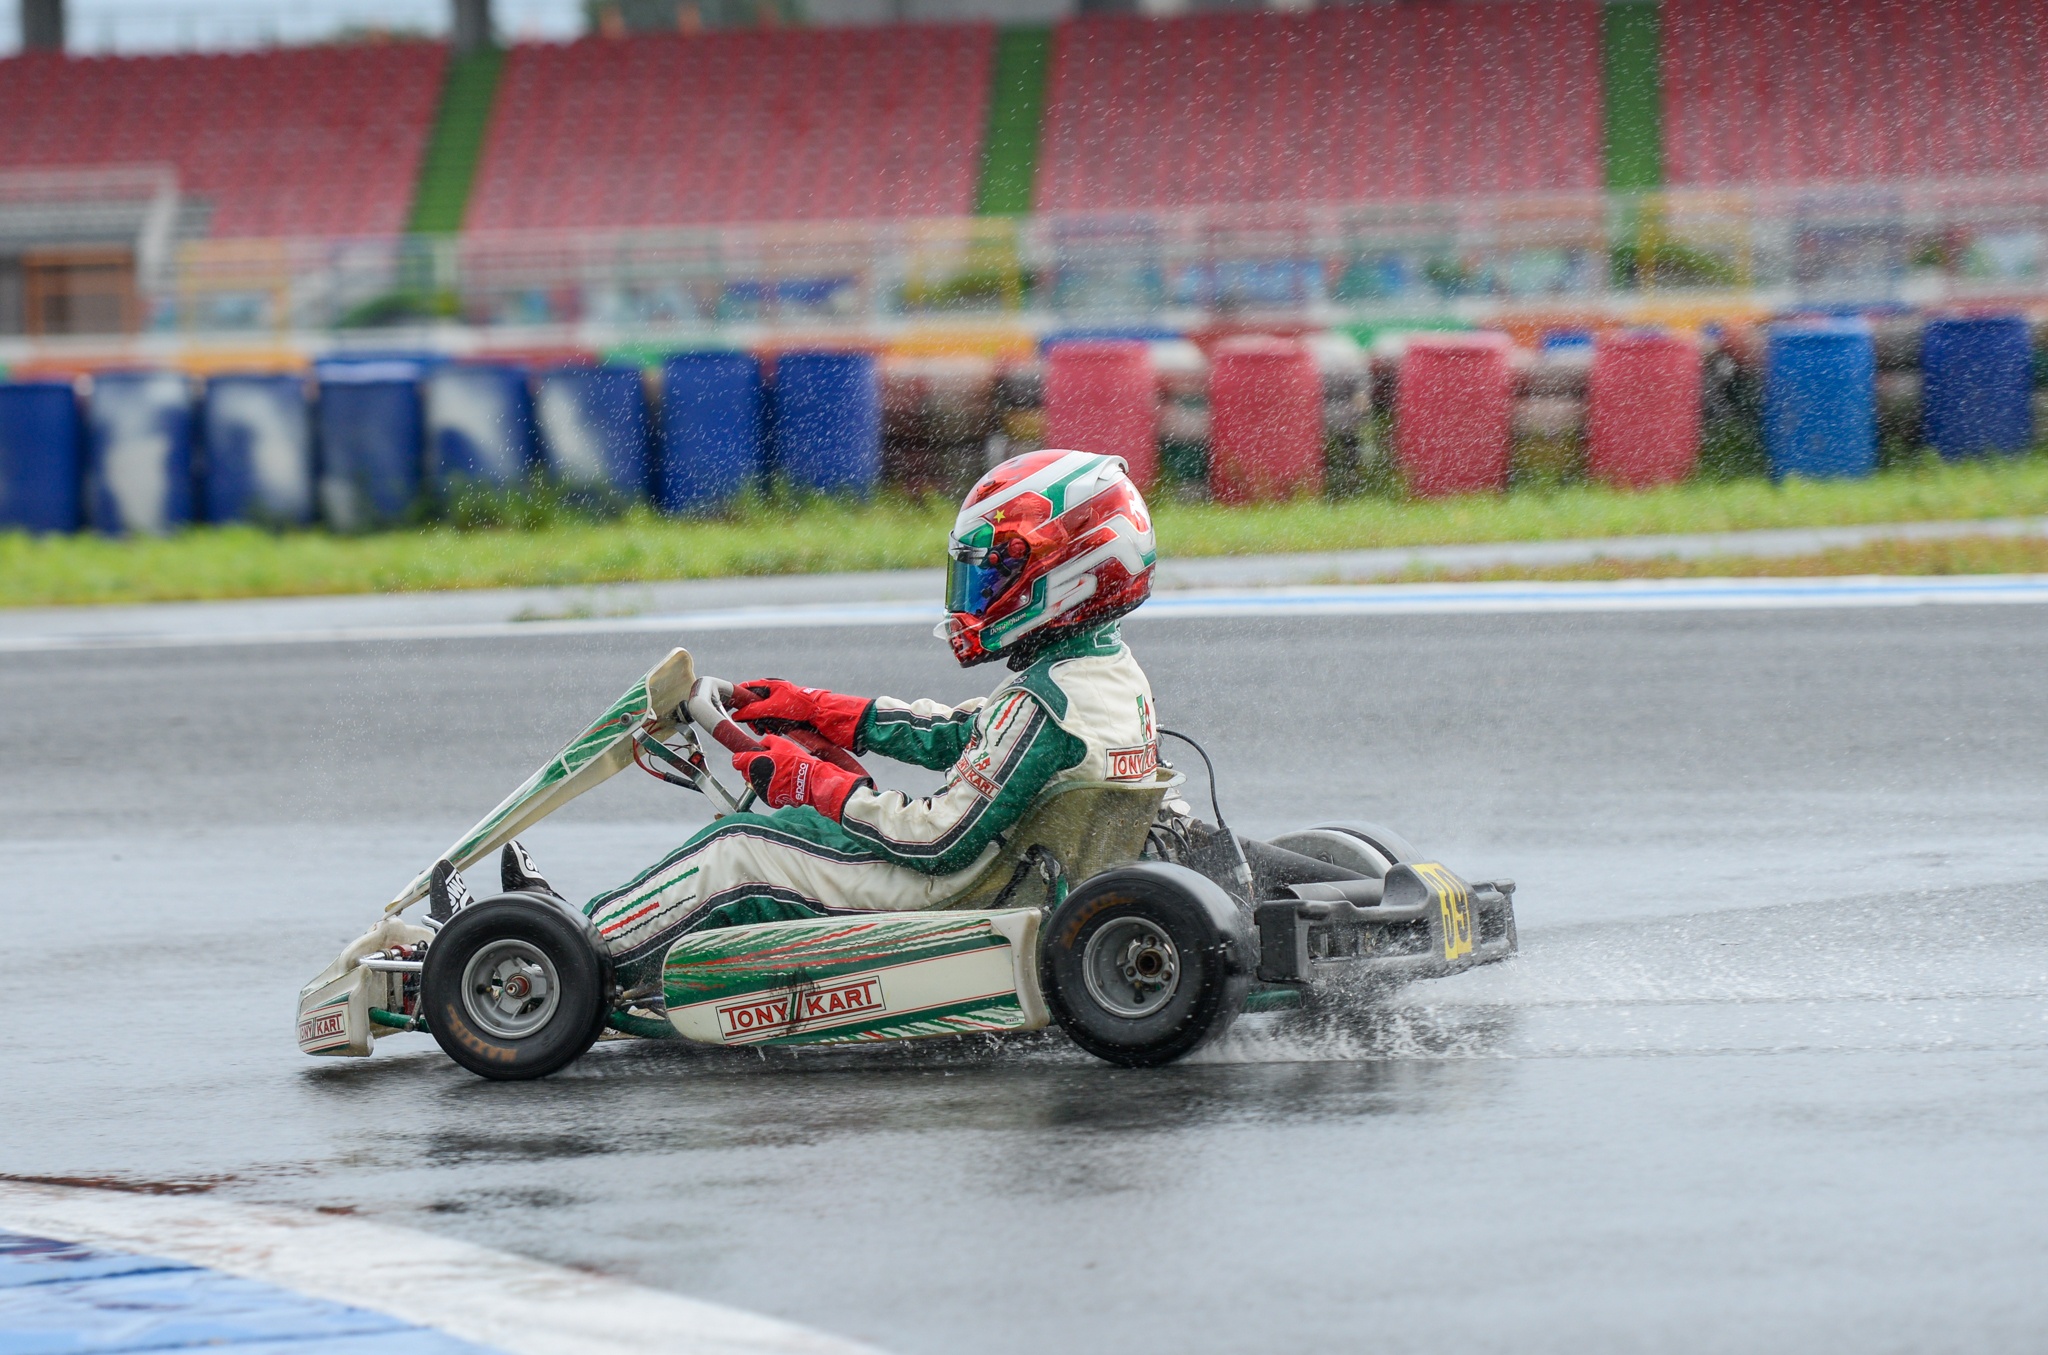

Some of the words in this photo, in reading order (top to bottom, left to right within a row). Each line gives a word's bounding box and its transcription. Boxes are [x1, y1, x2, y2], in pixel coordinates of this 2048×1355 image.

[1109, 749, 1144, 776] TONY
[796, 762, 808, 801] sparco
[966, 768, 1000, 795] KART
[719, 997, 788, 1030] TONY
[805, 980, 877, 1015] KART
[316, 1013, 342, 1036] KART
